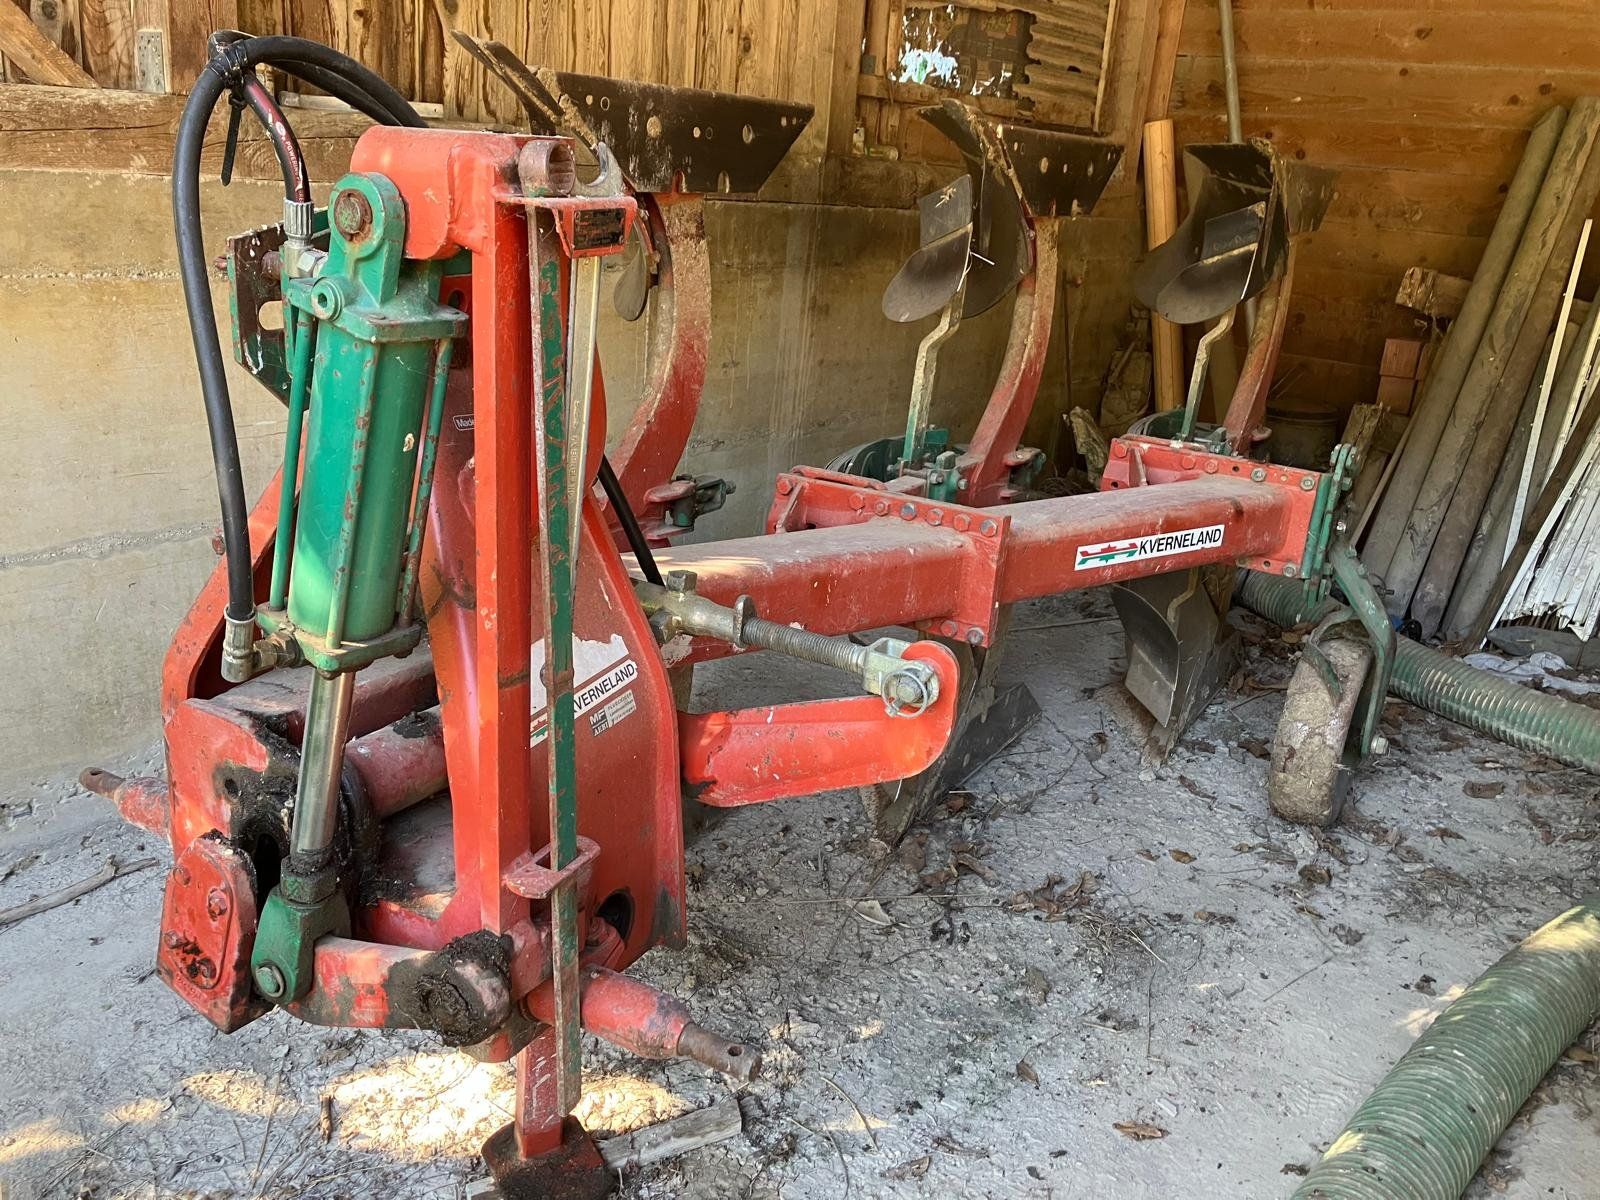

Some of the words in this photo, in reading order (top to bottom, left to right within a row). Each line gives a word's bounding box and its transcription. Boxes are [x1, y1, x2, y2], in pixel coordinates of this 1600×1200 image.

[286, 141, 299, 176] POWERING
[1138, 528, 1222, 556] KVERNELAND
[574, 664, 635, 713] VERNELAND
[589, 708, 606, 725] MF
